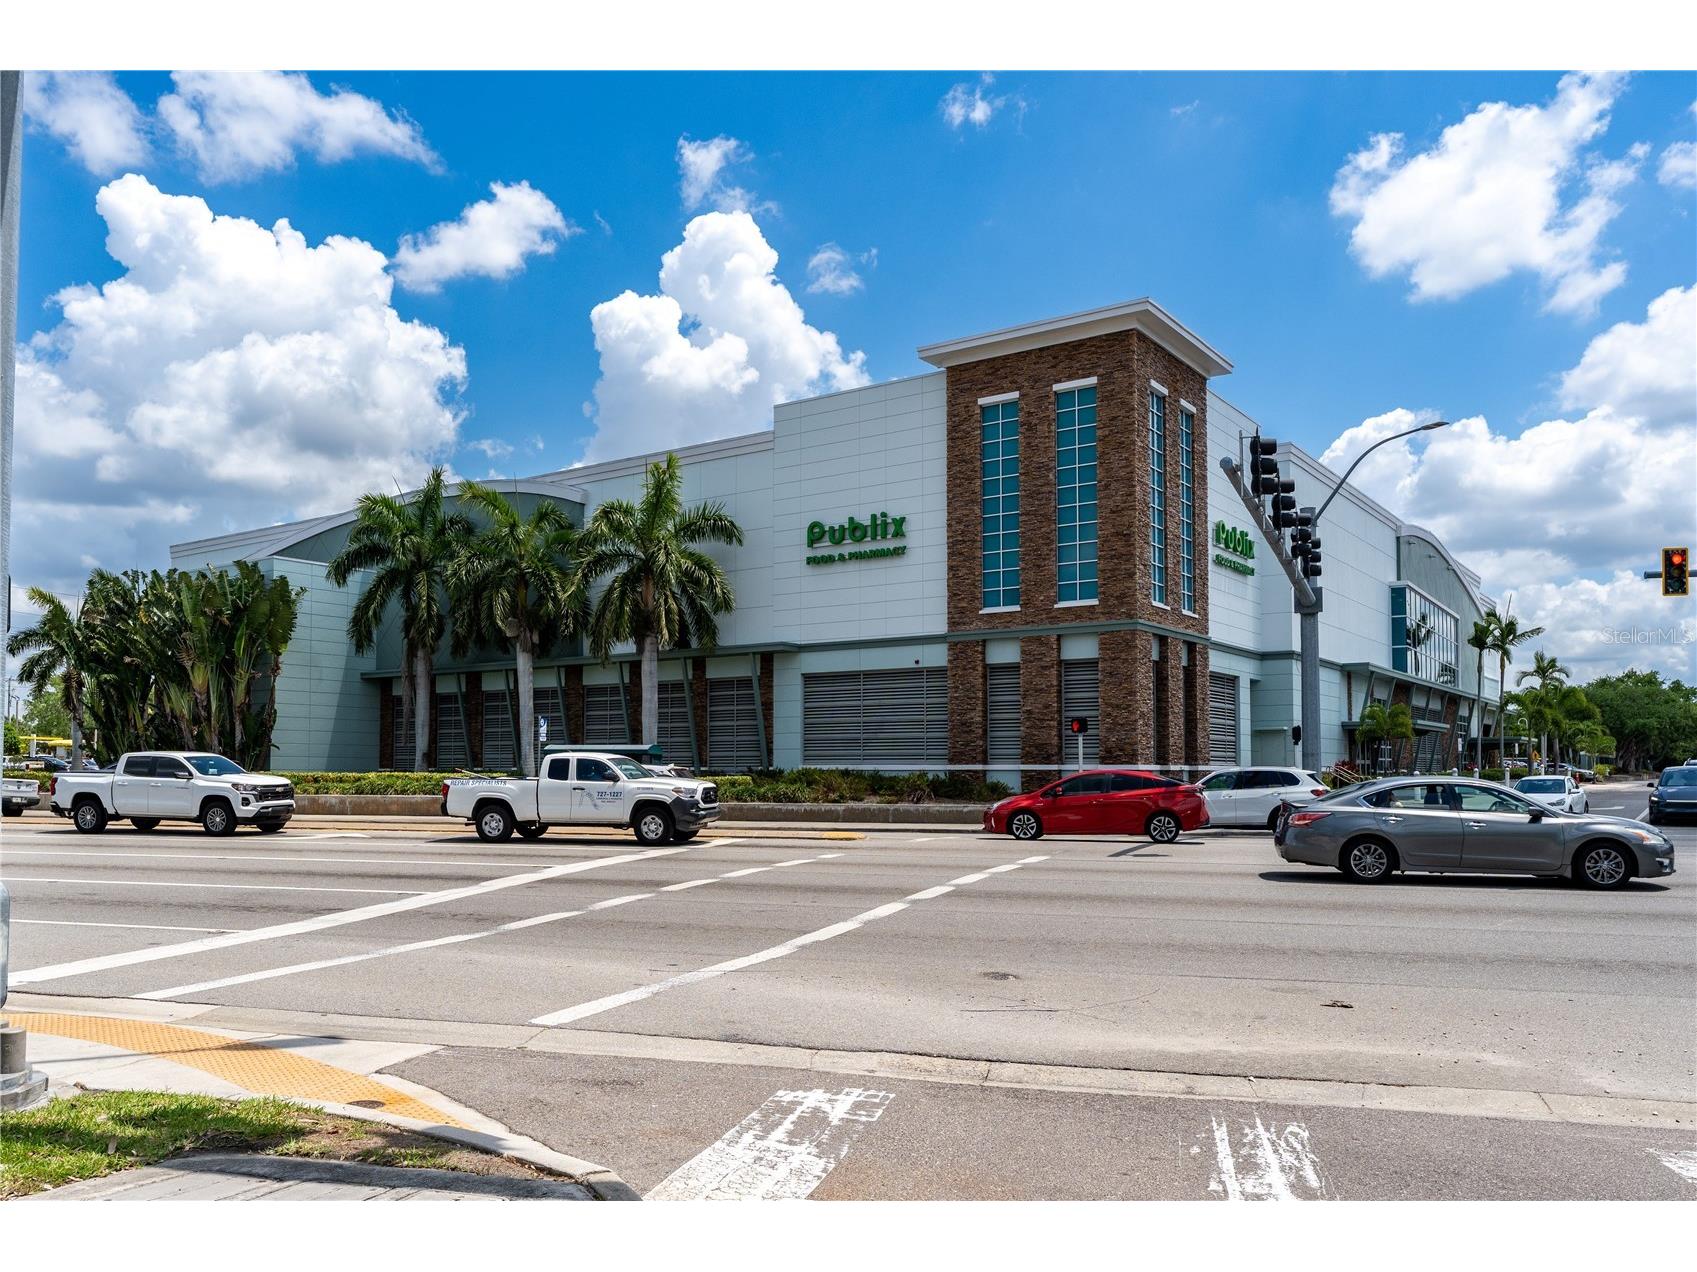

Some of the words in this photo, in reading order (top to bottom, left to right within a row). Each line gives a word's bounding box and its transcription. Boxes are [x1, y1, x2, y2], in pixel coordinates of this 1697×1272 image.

[807, 512, 906, 548] Publix
[1216, 520, 1255, 559] Publix
[806, 555, 836, 565] FOOD
[837, 553, 846, 561] &
[848, 546, 907, 560] PHARMACY
